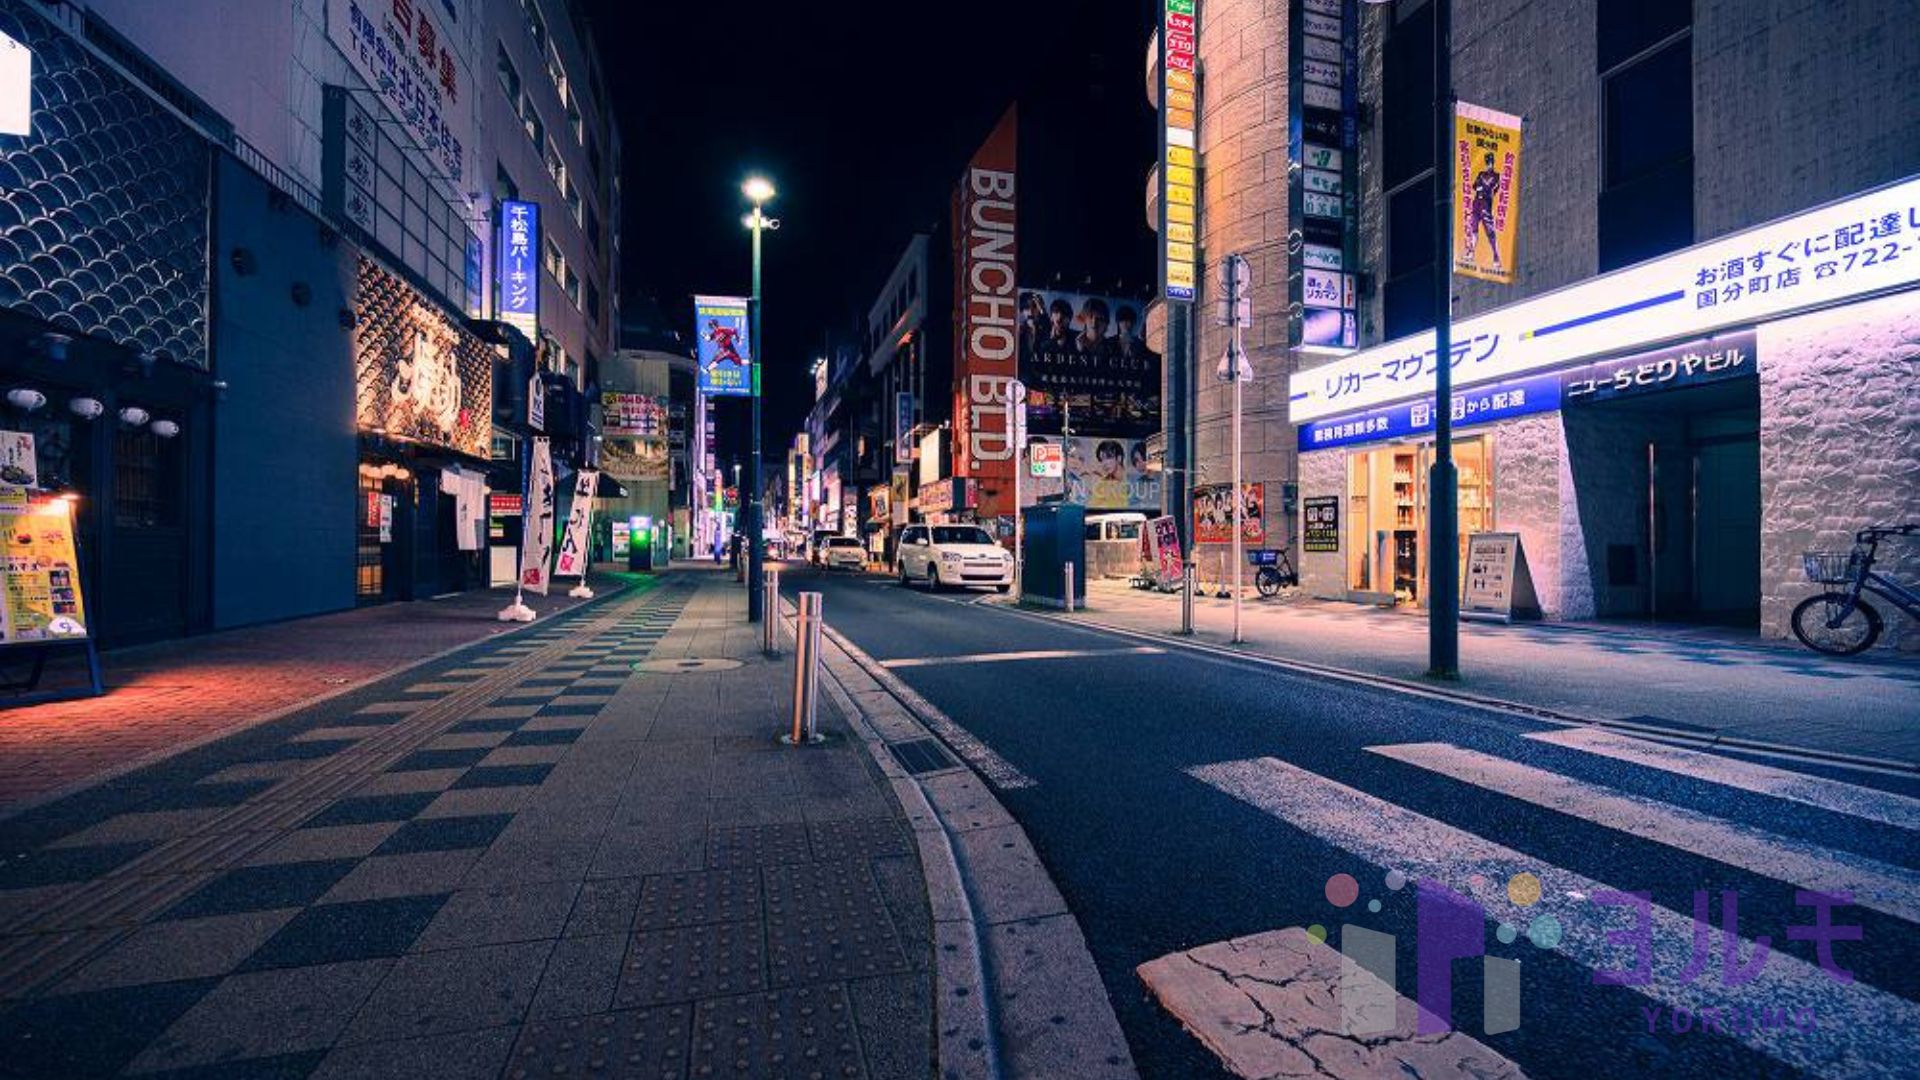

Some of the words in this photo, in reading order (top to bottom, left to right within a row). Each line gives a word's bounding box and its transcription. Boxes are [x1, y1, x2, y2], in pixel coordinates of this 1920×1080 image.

[349, 27, 378, 79] TEL
[970, 167, 1015, 361] BUNCHO
[1696, 266, 1802, 310] 国分町店
[1567, 348, 1747, 397] ニューちどりやビル
[970, 374, 1015, 470] BLD.
